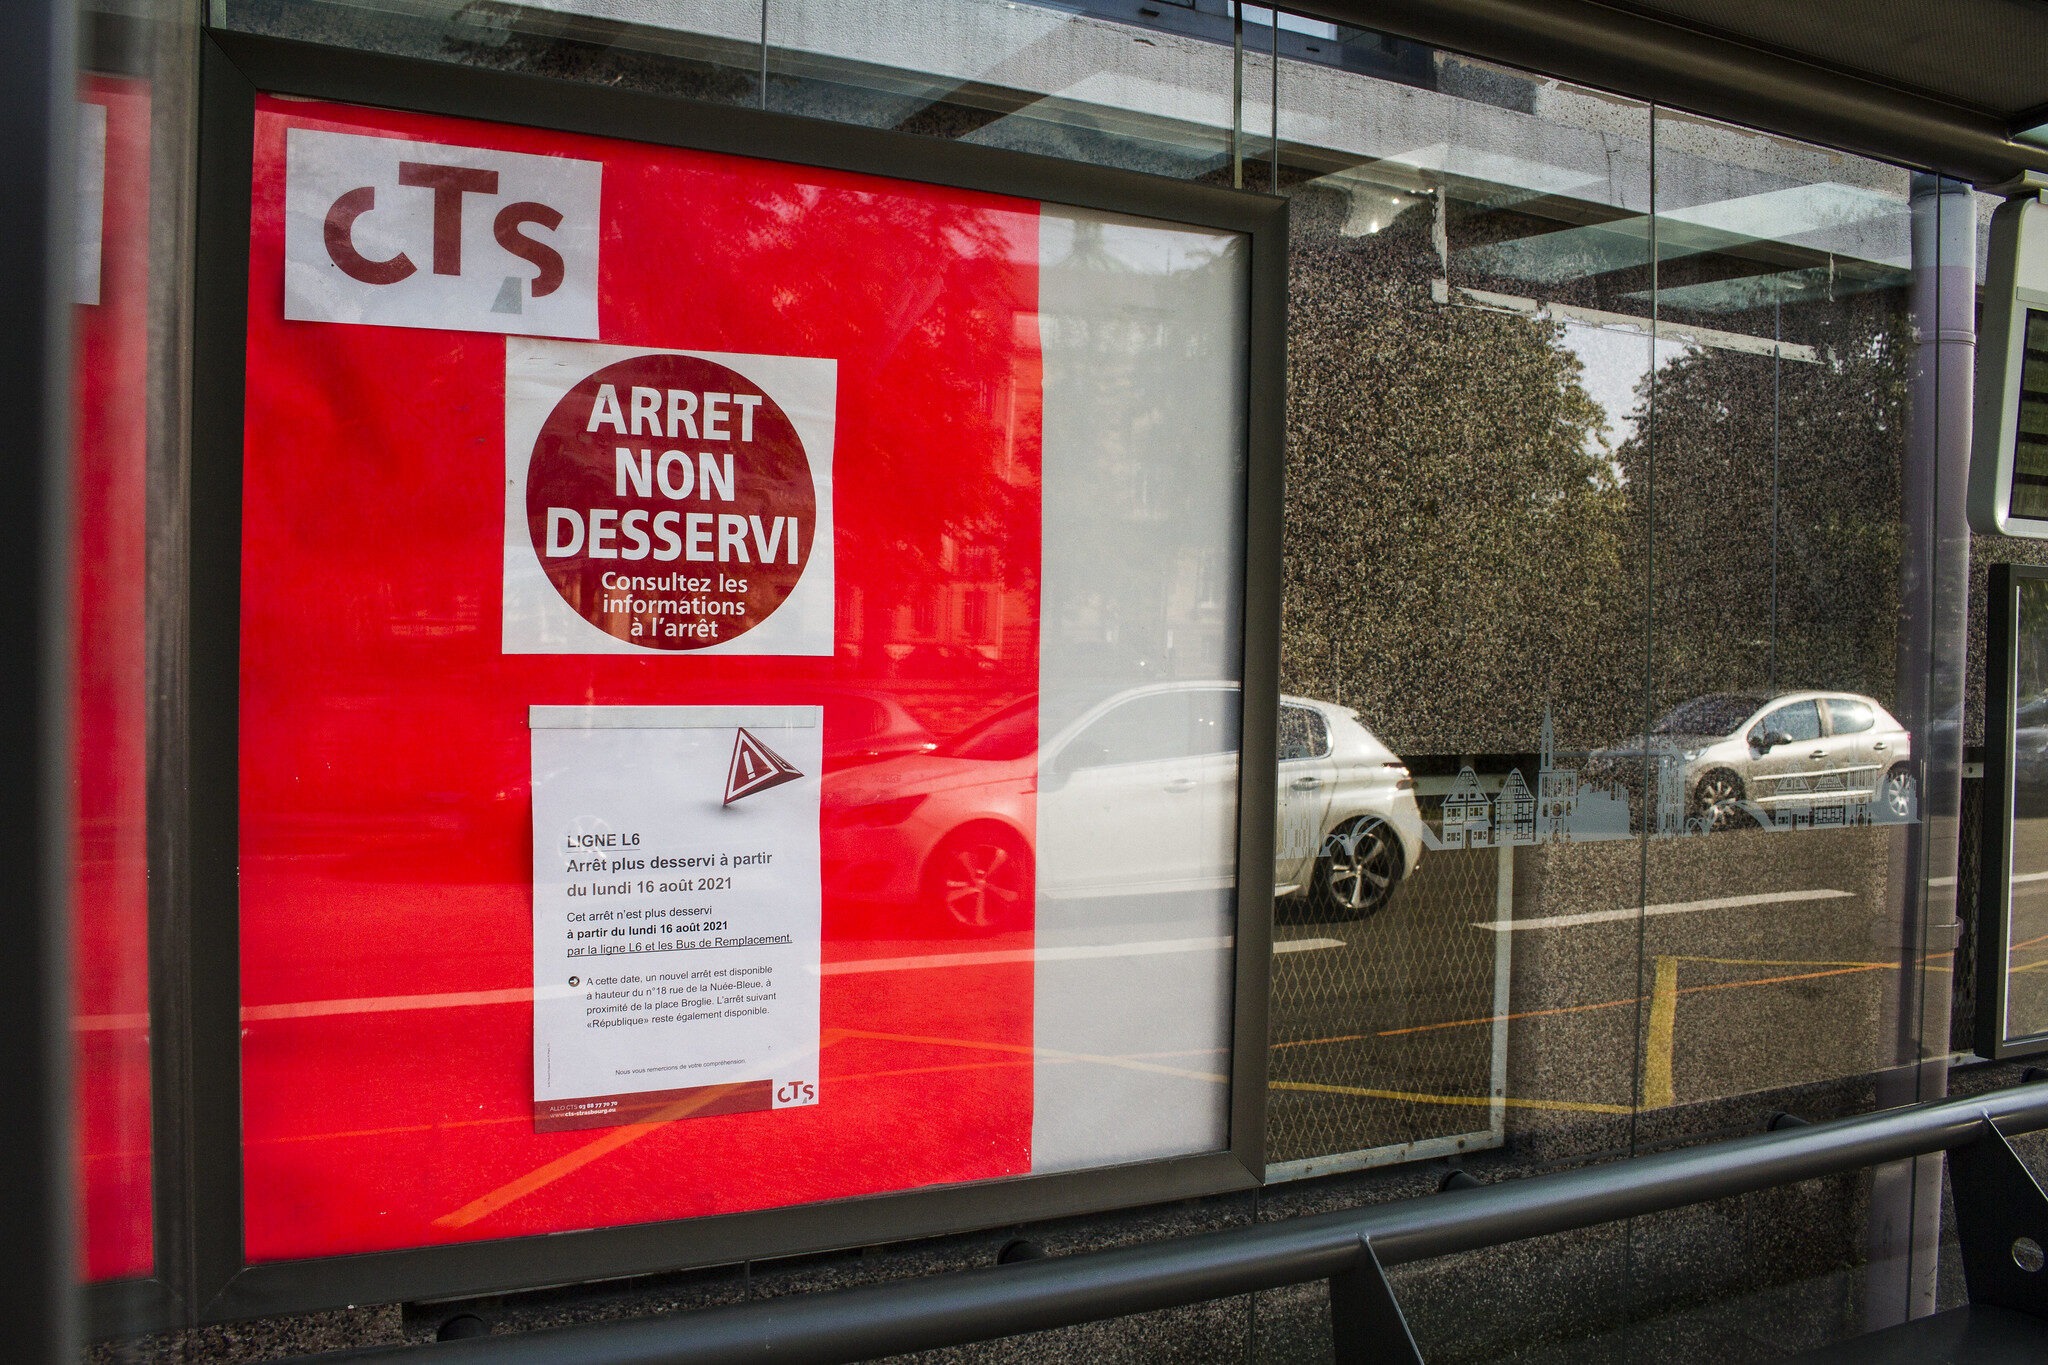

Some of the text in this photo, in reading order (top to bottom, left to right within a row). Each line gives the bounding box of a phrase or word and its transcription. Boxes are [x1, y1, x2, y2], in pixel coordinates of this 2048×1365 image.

[324, 161, 565, 300] CTS
[586, 383, 763, 442] ARRET
[615, 447, 735, 502] NON
[545, 506, 799, 565] DESSERVI
[601, 571, 748, 593] Consultez les
[602, 594, 746, 616] informations
[630, 617, 718, 638] à l'arrêt
[566, 833, 641, 849] LIGNE L6
[566, 852, 773, 874] Arrêt plus desservi à partir
[567, 876, 732, 898] du lundi 16 août 2021
[567, 906, 713, 923] Cet arrêt n'est plus desservi
[567, 921, 729, 941] à partir du lundi 16 août 2021
[567, 933, 793, 957] par la ligne L6 et les Bus de Remplacement.
[587, 978, 593, 986] A
[593, 976, 618, 986] cette
[646, 974, 657, 982] un
[659, 971, 689, 981] nouvel
[691, 969, 711, 979] arrêt
[714, 968, 727, 977] est
[729, 965, 773, 978] disponible
[586, 992, 593, 1000] à
[595, 989, 630, 1000] hauteur
[632, 988, 644, 997] du
[646, 986, 667, 996] n°18
[669, 986, 684, 995] rue
[686, 984, 697, 994] de
[700, 983, 708, 992] la
[765, 979, 772, 988] à
[586, 1003, 628, 1016] proximité
[630, 1002, 642, 1011] de
[645, 1001, 652, 1010] la
[655, 998, 679, 1011] place
[717, 994, 744, 1005] L'arrêt
[746, 992, 776, 1003] suivant
[587, 1007, 770, 1029] «République» reste également disponible.
[615, 1068, 631, 1076] Nous
[646, 1065, 678, 1073] remercions
[777, 1081, 814, 1103] CTS
